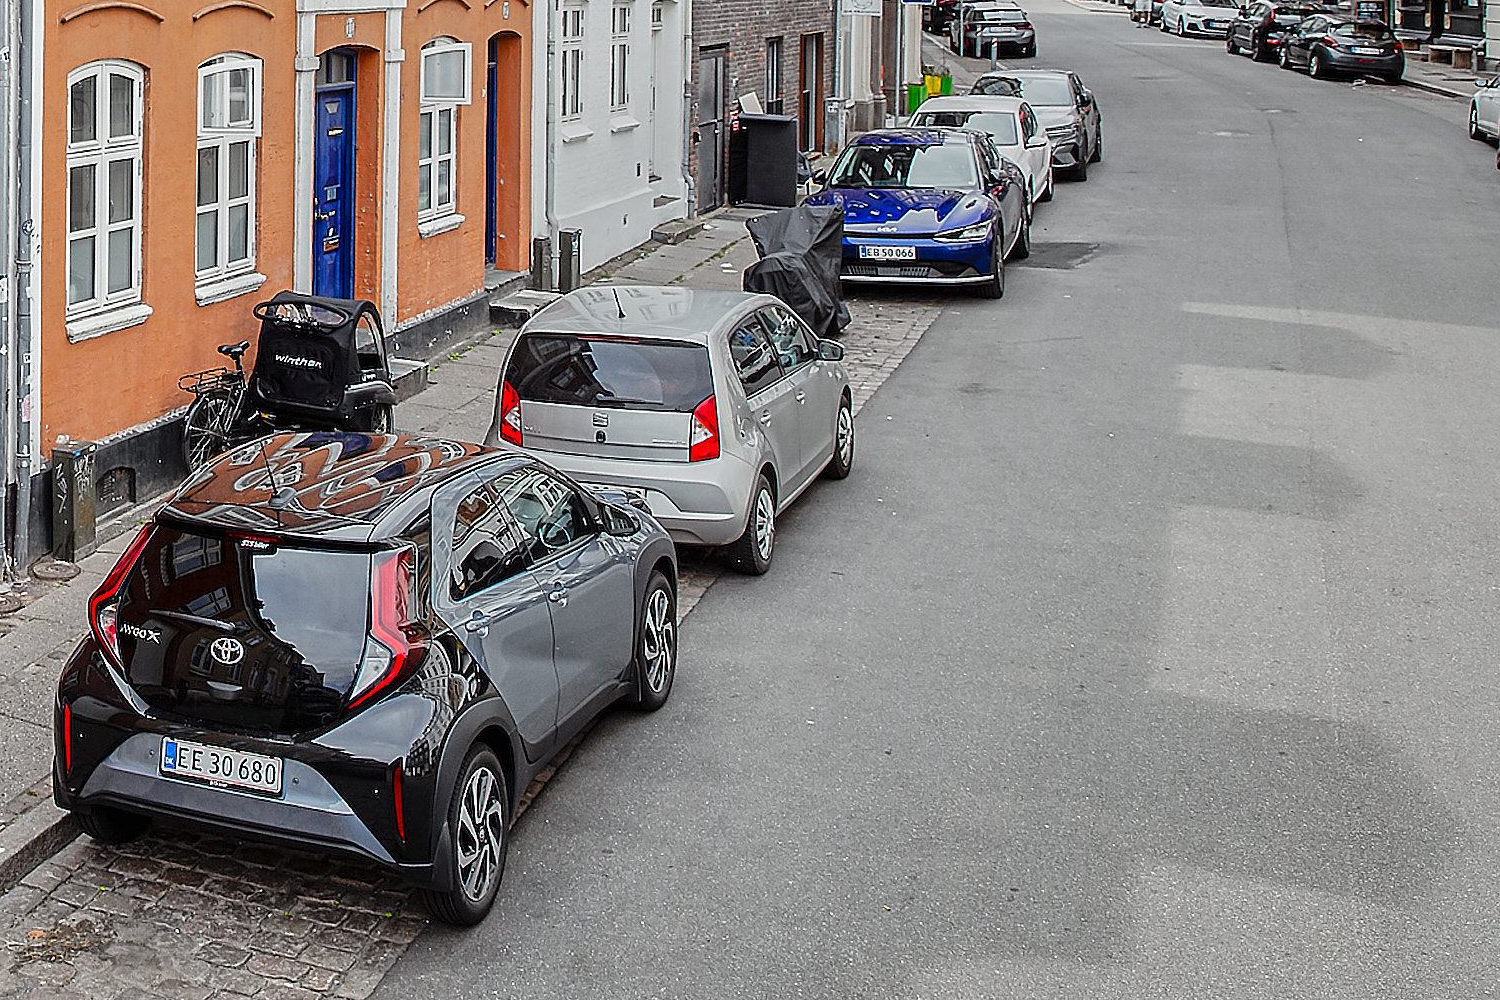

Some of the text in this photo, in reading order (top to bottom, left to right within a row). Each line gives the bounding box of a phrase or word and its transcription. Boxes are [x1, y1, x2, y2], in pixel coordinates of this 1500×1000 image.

[882, 248, 894, 257] 50
[896, 248, 914, 258] 066
[178, 747, 276, 785] EE 30 680
